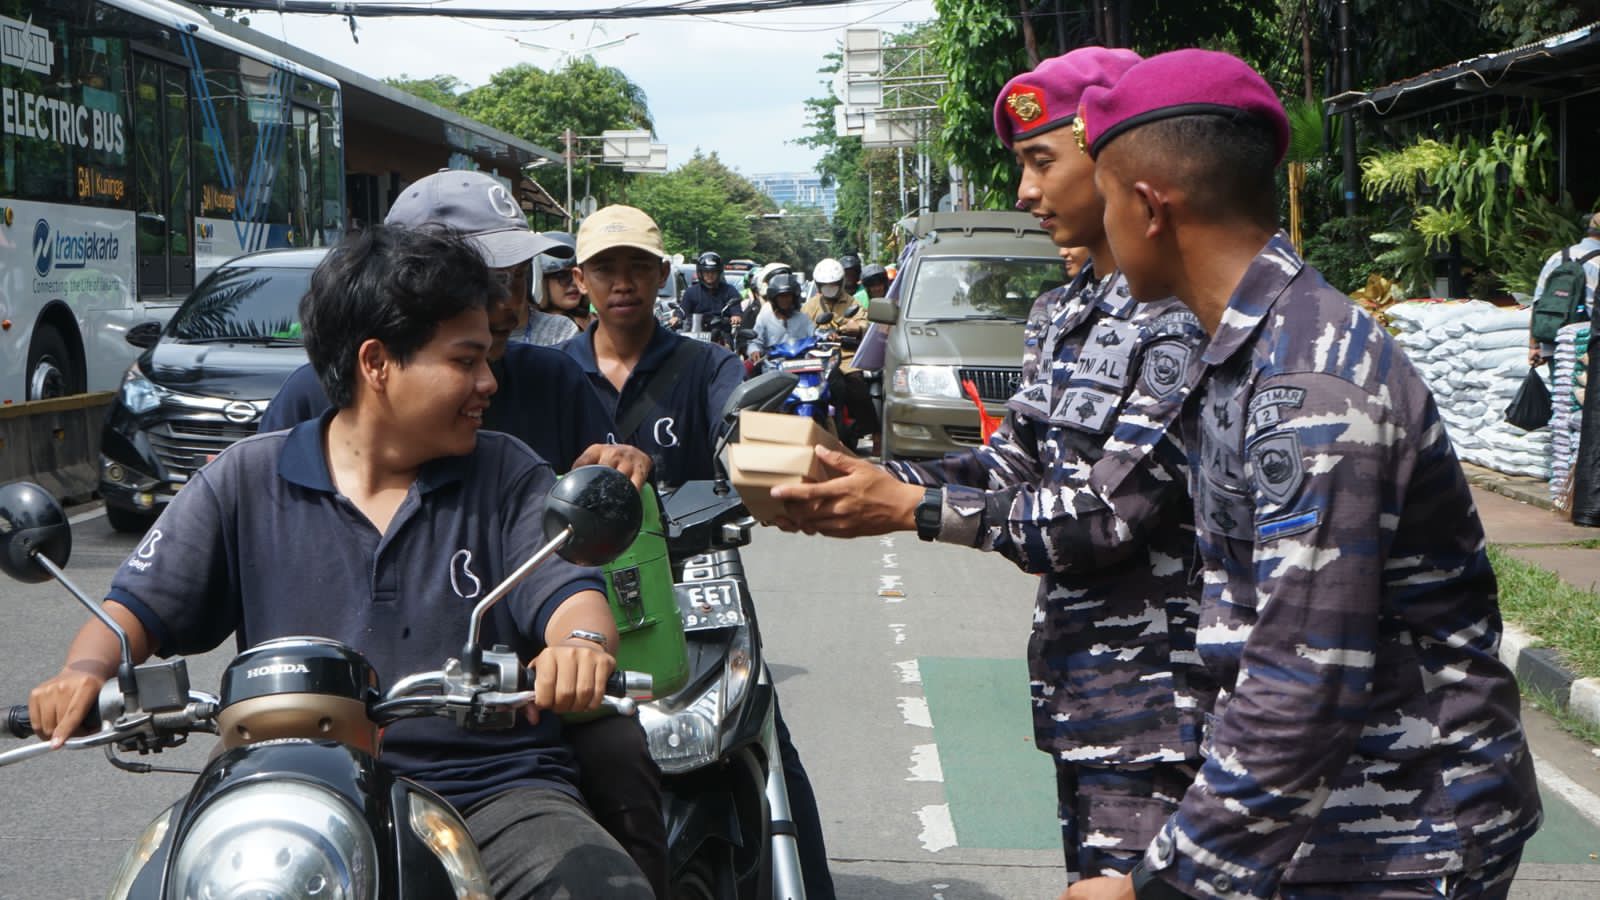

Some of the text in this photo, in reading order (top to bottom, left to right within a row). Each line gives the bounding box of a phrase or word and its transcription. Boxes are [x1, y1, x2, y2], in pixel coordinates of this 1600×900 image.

[2, 87, 125, 155] ELECTRIC BUS
[55, 230, 119, 266] transjakarta
[1096, 358, 1120, 380] AL
[1263, 410, 1271, 422] 2
[688, 585, 731, 608] EET
[247, 663, 311, 680] HONDA
